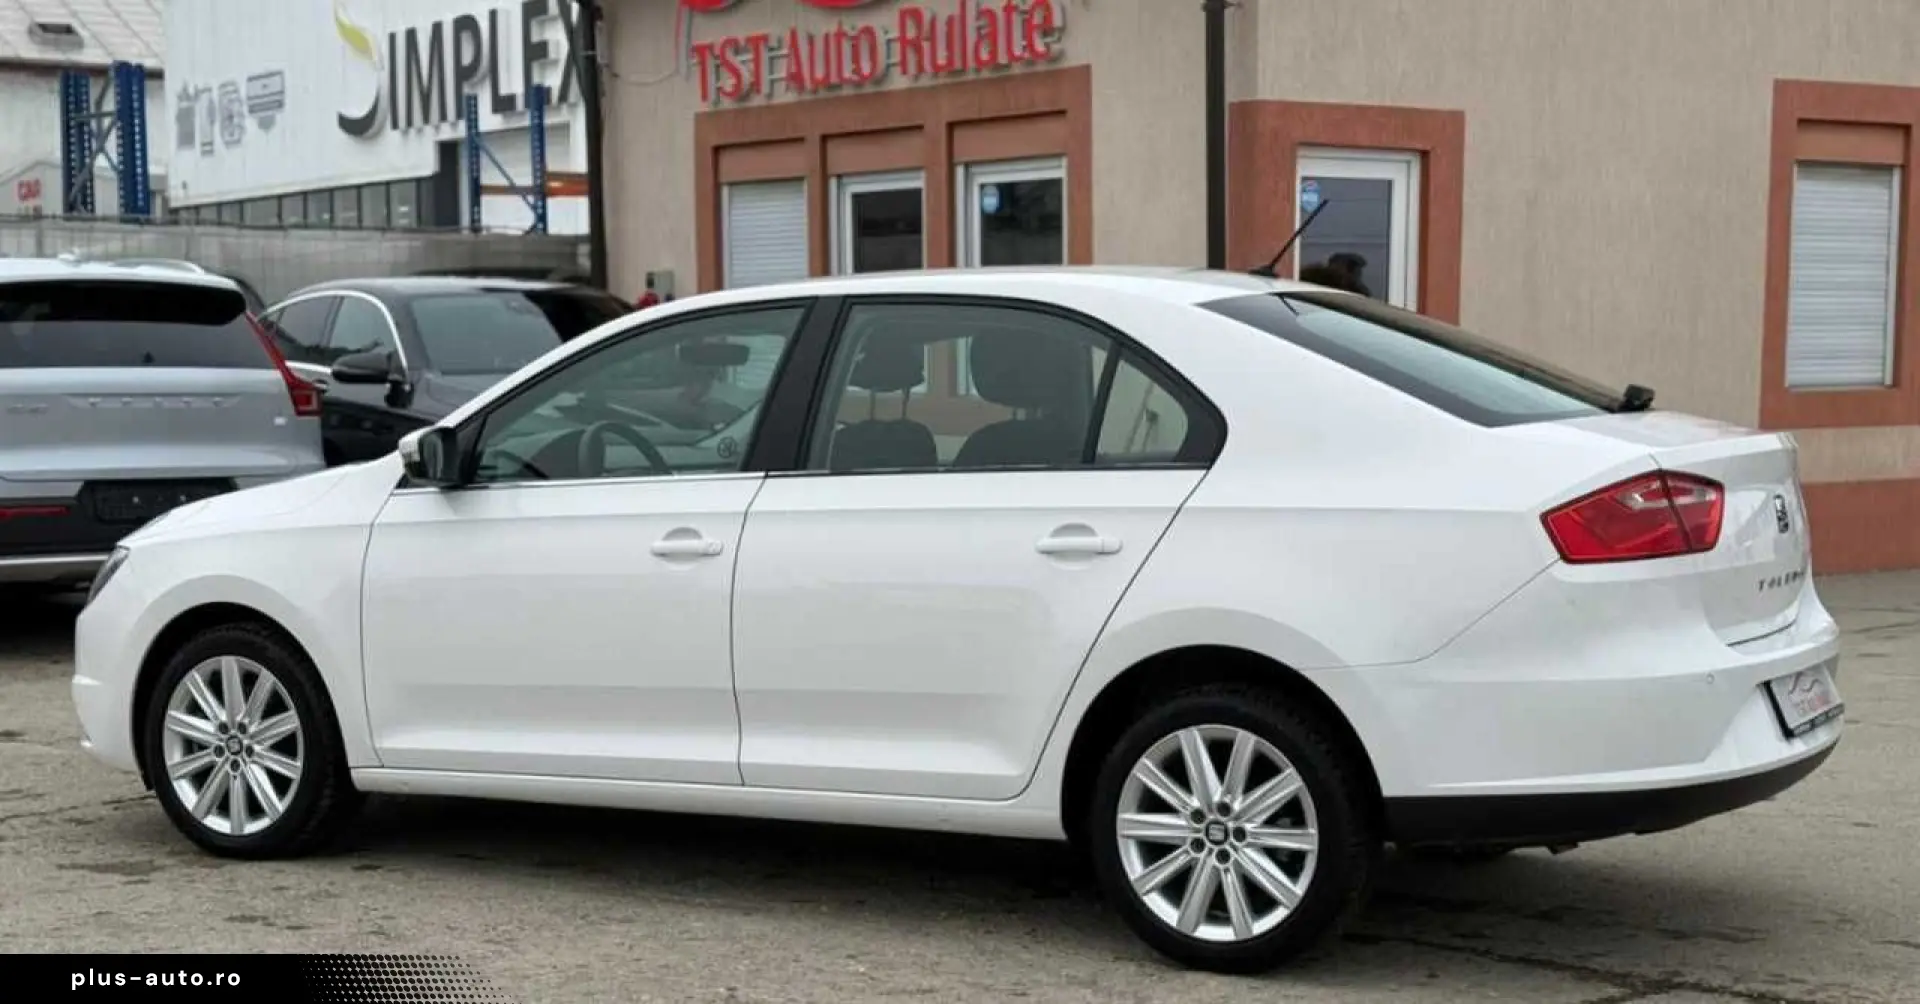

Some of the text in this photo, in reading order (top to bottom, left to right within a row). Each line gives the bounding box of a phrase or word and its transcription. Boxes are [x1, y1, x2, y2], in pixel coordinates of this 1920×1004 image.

[334, 0, 581, 137] SIMPLEX
[691, 0, 1054, 102] TST Auto Rulate
